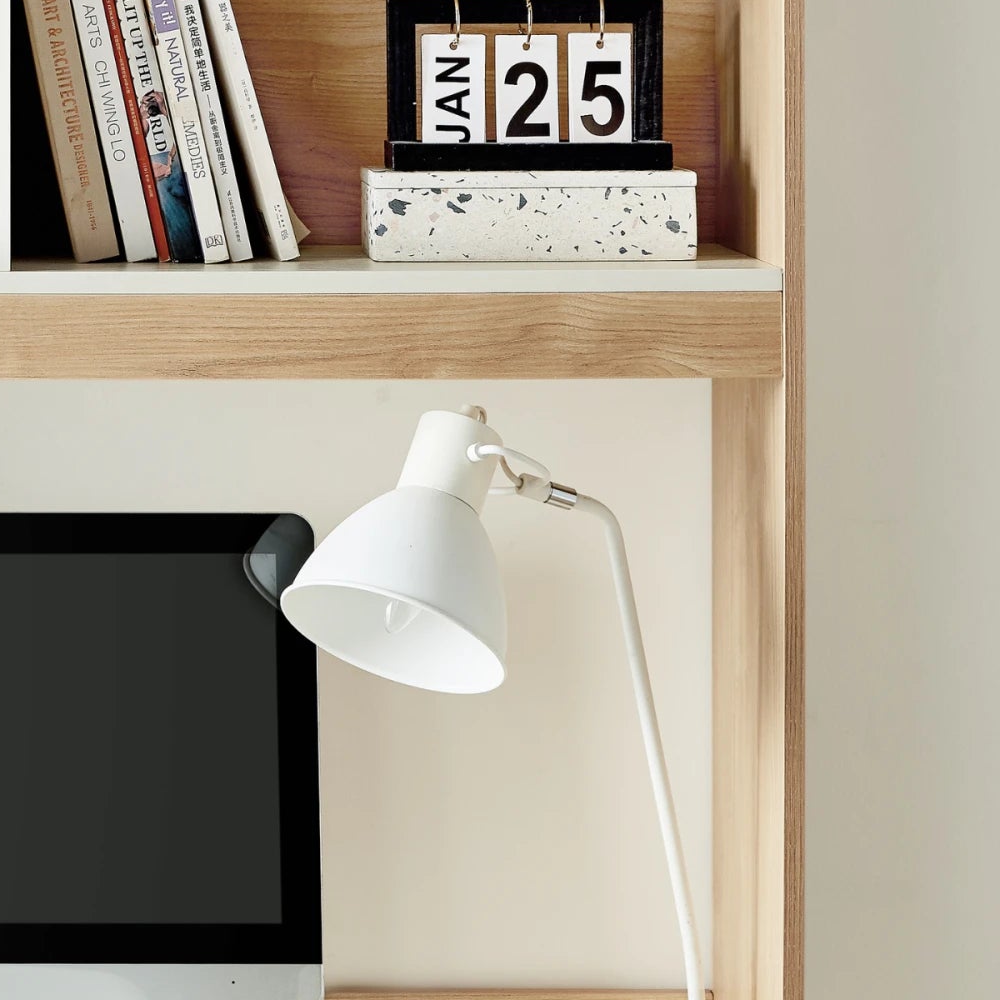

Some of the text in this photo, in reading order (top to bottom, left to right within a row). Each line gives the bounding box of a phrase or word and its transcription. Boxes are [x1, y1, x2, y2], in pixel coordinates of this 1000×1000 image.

[47, 26, 63, 38] &
[82, 2, 103, 49] ARTS
[129, 26, 145, 50] UP
[161, 10, 176, 25] it!
[135, 51, 153, 88] THE
[165, 37, 189, 102] NATURAL
[184, 4, 211, 92] 我决定简单地生活
[49, 39, 84, 144] ARCHITECTURE
[94, 60, 111, 89] CHI
[100, 91, 121, 137] WING
[143, 89, 168, 153] WORLD
[436, 57, 625, 143] JAN 2 5
[72, 143, 91, 188] DESIGNER
[110, 139, 127, 163] LO
[181, 114, 206, 180] MEDIES
[206, 235, 223, 247] DK
